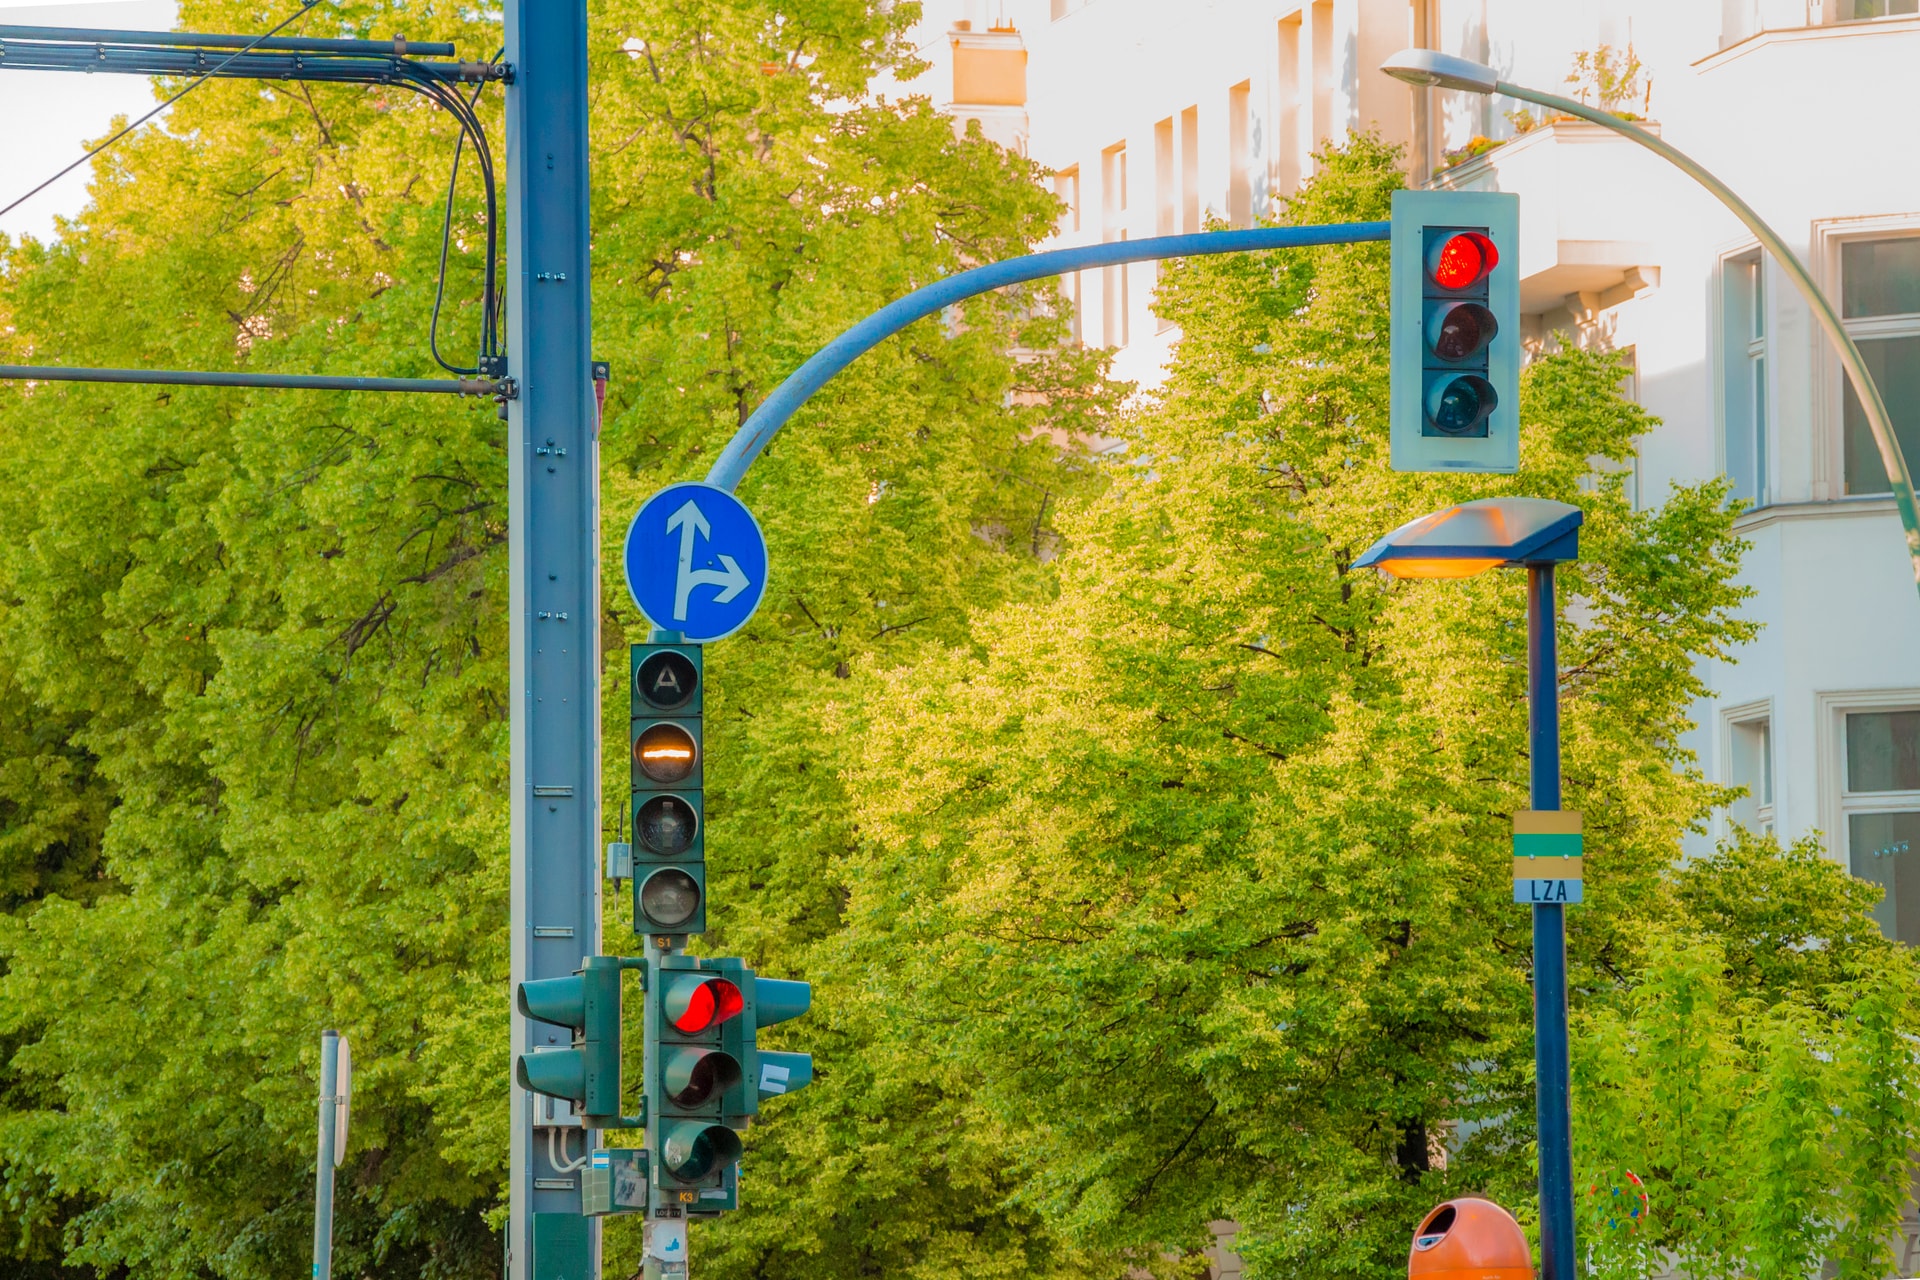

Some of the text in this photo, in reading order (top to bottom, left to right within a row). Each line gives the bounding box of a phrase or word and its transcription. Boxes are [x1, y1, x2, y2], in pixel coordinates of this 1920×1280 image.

[653, 664, 681, 693] A
[1531, 880, 1567, 901] LZA
[657, 937, 670, 948] S1
[679, 1191, 693, 1203] K3
